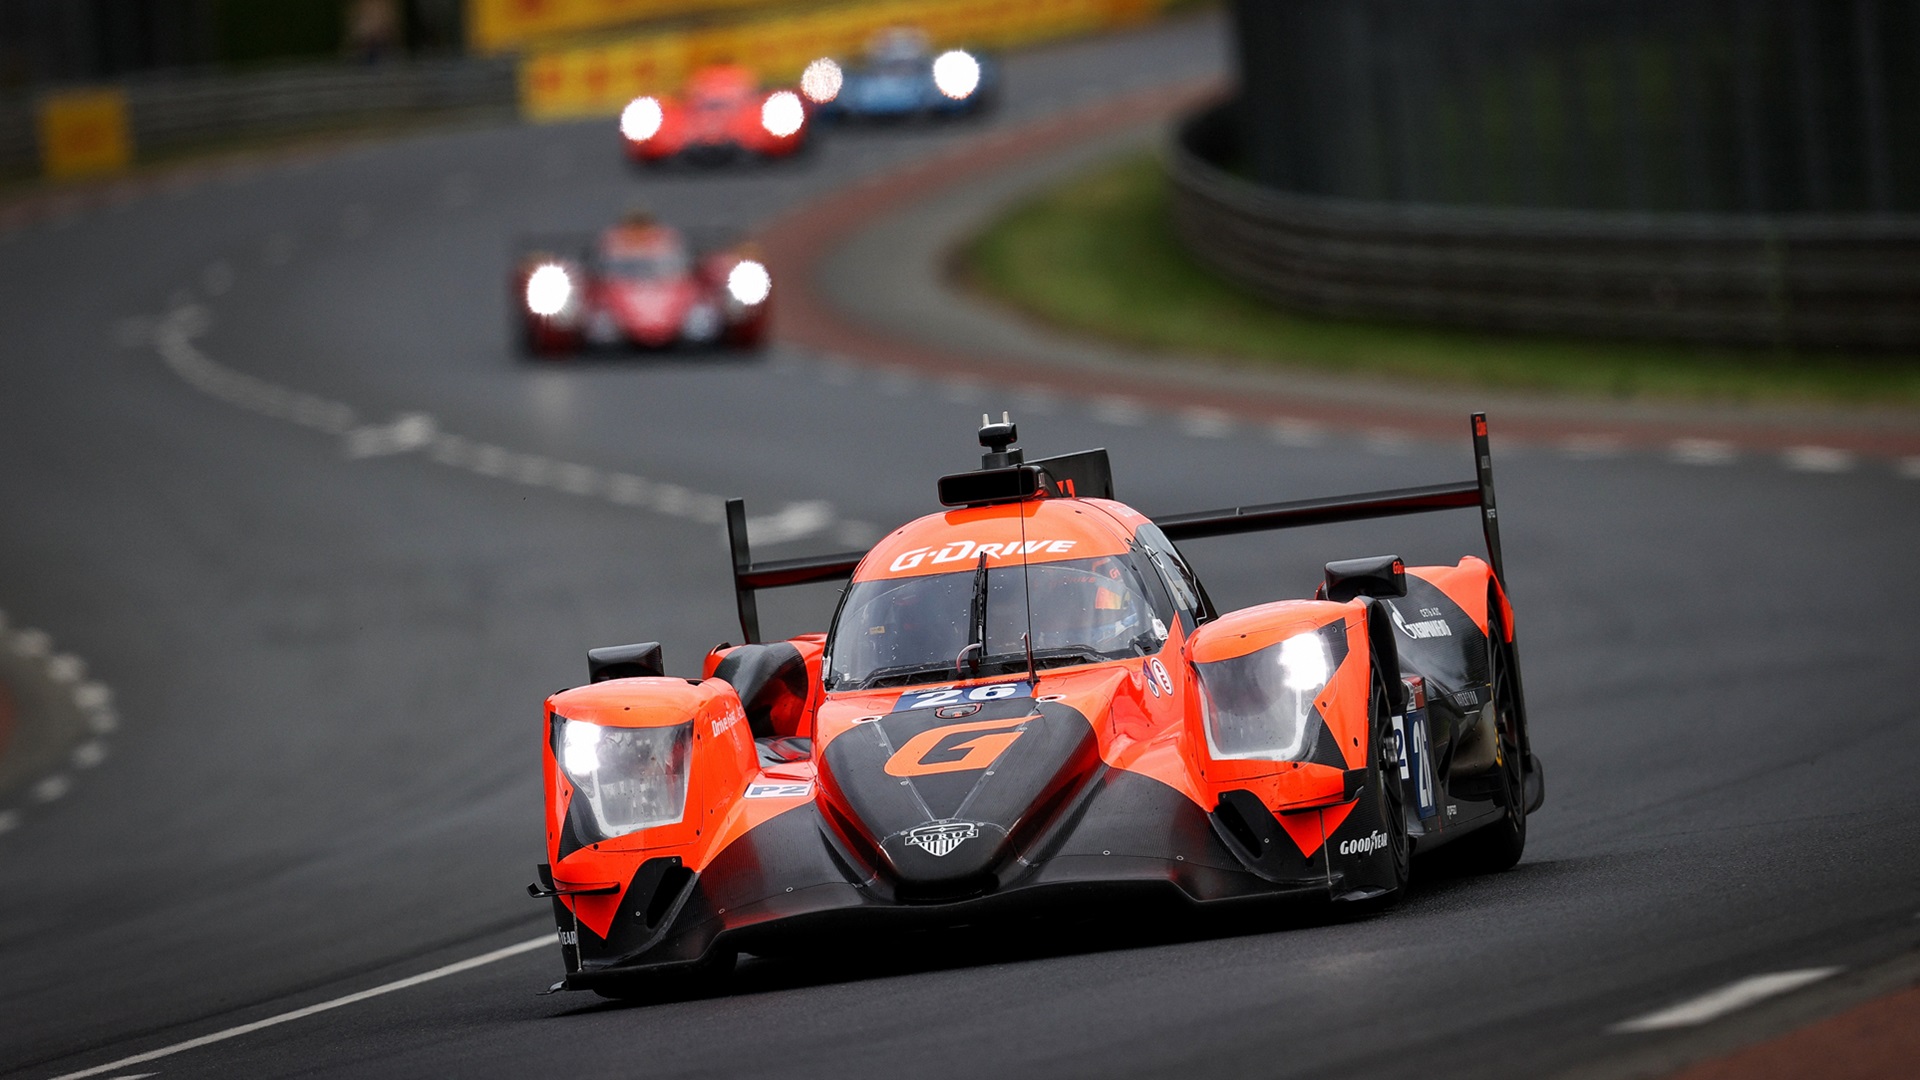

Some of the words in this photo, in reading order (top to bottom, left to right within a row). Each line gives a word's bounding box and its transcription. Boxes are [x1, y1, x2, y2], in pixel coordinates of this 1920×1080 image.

[910, 683, 1018, 709] 26
[711, 716, 729, 738] Drive
[1412, 719, 1433, 808] 26
[750, 786, 807, 796] P2
[908, 830, 975, 845] AURUS
